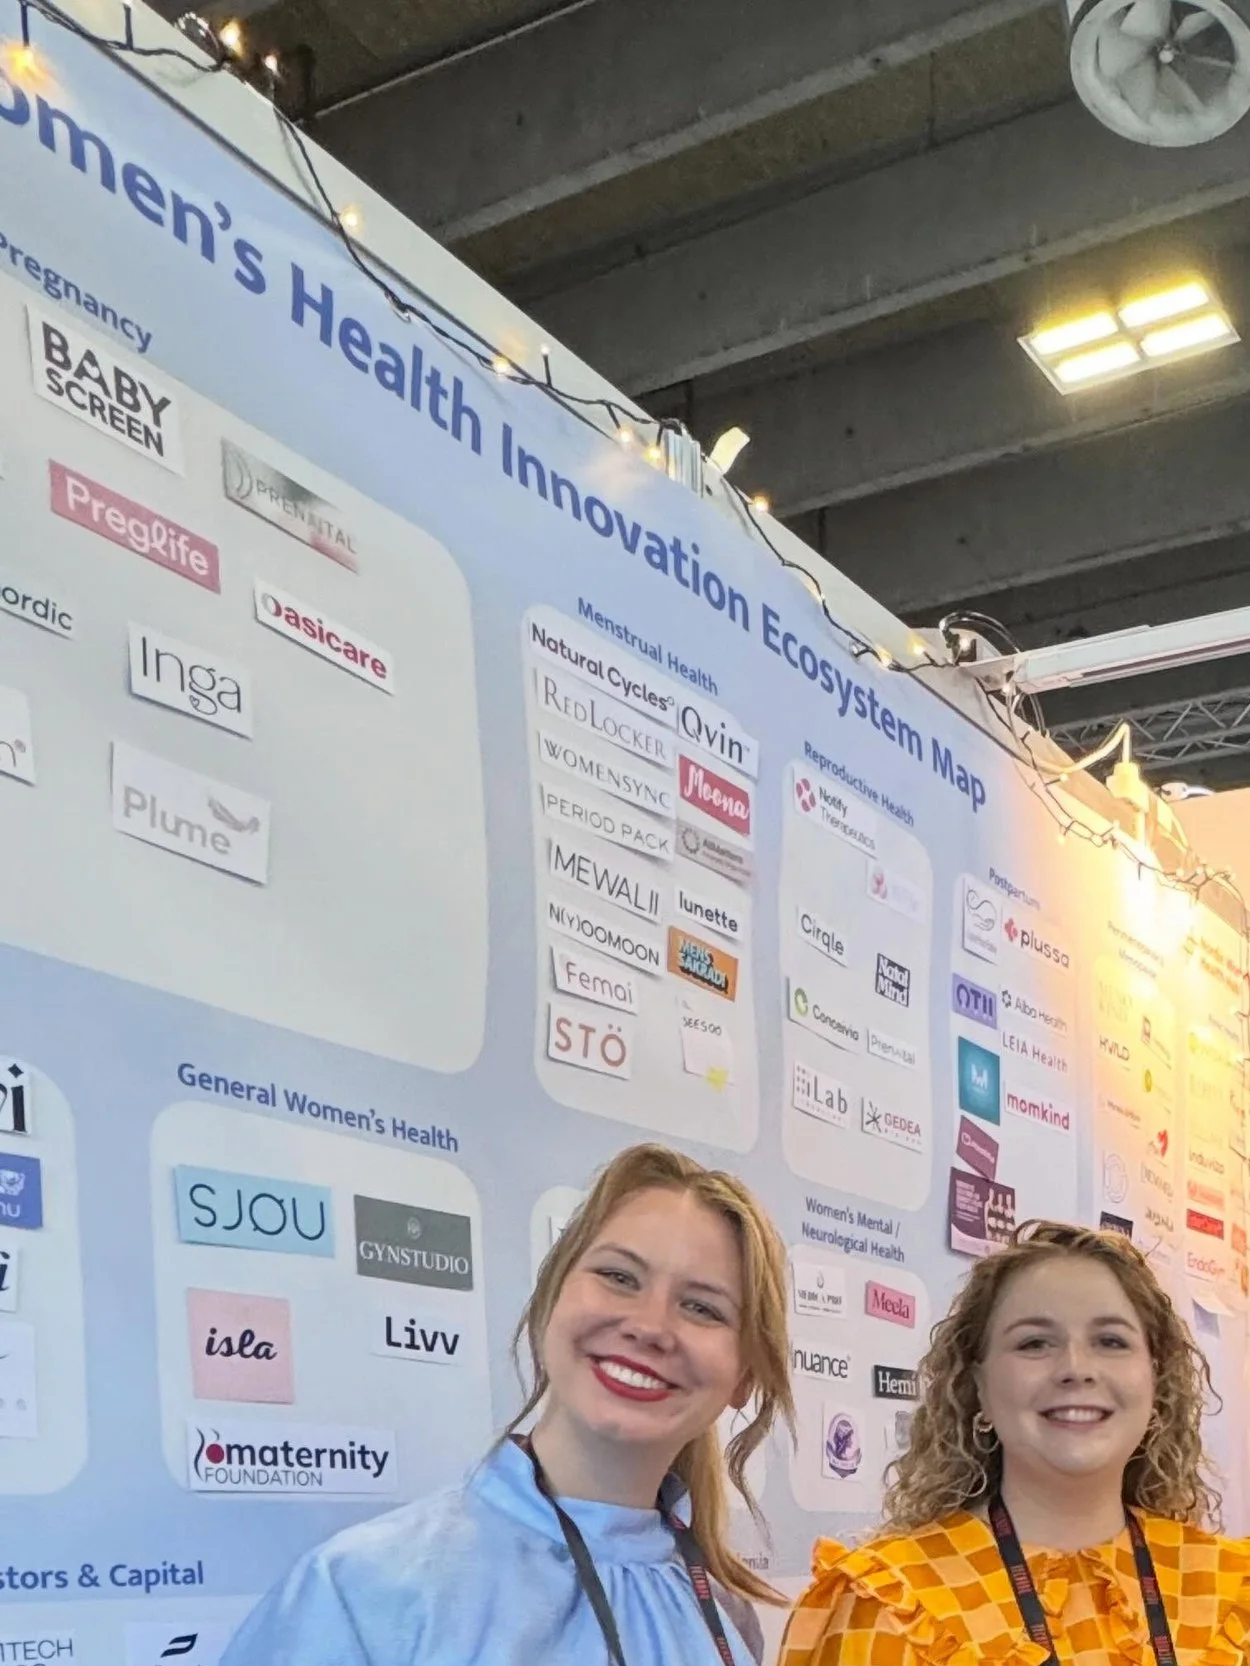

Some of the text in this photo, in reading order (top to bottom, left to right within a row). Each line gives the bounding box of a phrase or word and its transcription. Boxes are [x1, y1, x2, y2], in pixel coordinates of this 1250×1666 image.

[0, 231, 153, 354] regnancy
[42, 322, 171, 428] BABY
[46, 368, 164, 457] SCREEN
[64, 476, 210, 577] Preglife
[291, 262, 482, 457] Health
[502, 422, 749, 632] Innovation
[762, 603, 923, 763] Ecosystem
[932, 737, 986, 813] Map
[532, 622, 604, 680] Natural
[578, 597, 719, 696] Menstrual Health
[142, 637, 242, 716] Inga
[544, 738, 671, 810] WOMENSYNC
[684, 764, 749, 820] Moona
[804, 740, 915, 827] Reproductive Health
[123, 785, 232, 855] Plume
[547, 793, 669, 855] PERIOD PACK
[680, 891, 738, 932] lunette
[989, 867, 1041, 911] Postpartum
[801, 914, 844, 955] Cirqle
[555, 1016, 626, 1068] STÖ
[1003, 1032, 1068, 1073] LEIA Health
[177, 1062, 459, 1153] General Women's Health
[884, 1113, 922, 1137] GEDEA
[1007, 1093, 1070, 1130] momkind
[802, 1220, 905, 1263] Neurological Health
[805, 1196, 854, 1225] Women's
[857, 1211, 893, 1236] Mental
[359, 1239, 469, 1275] GYNSTUDIO
[205, 1327, 278, 1361] isla
[385, 1316, 460, 1356] Livv
[204, 1466, 323, 1487] FOUNDATION
[226, 1440, 389, 1478] maternity
[78, 1563, 100, 1588] &
[109, 1560, 204, 1594] Capital
